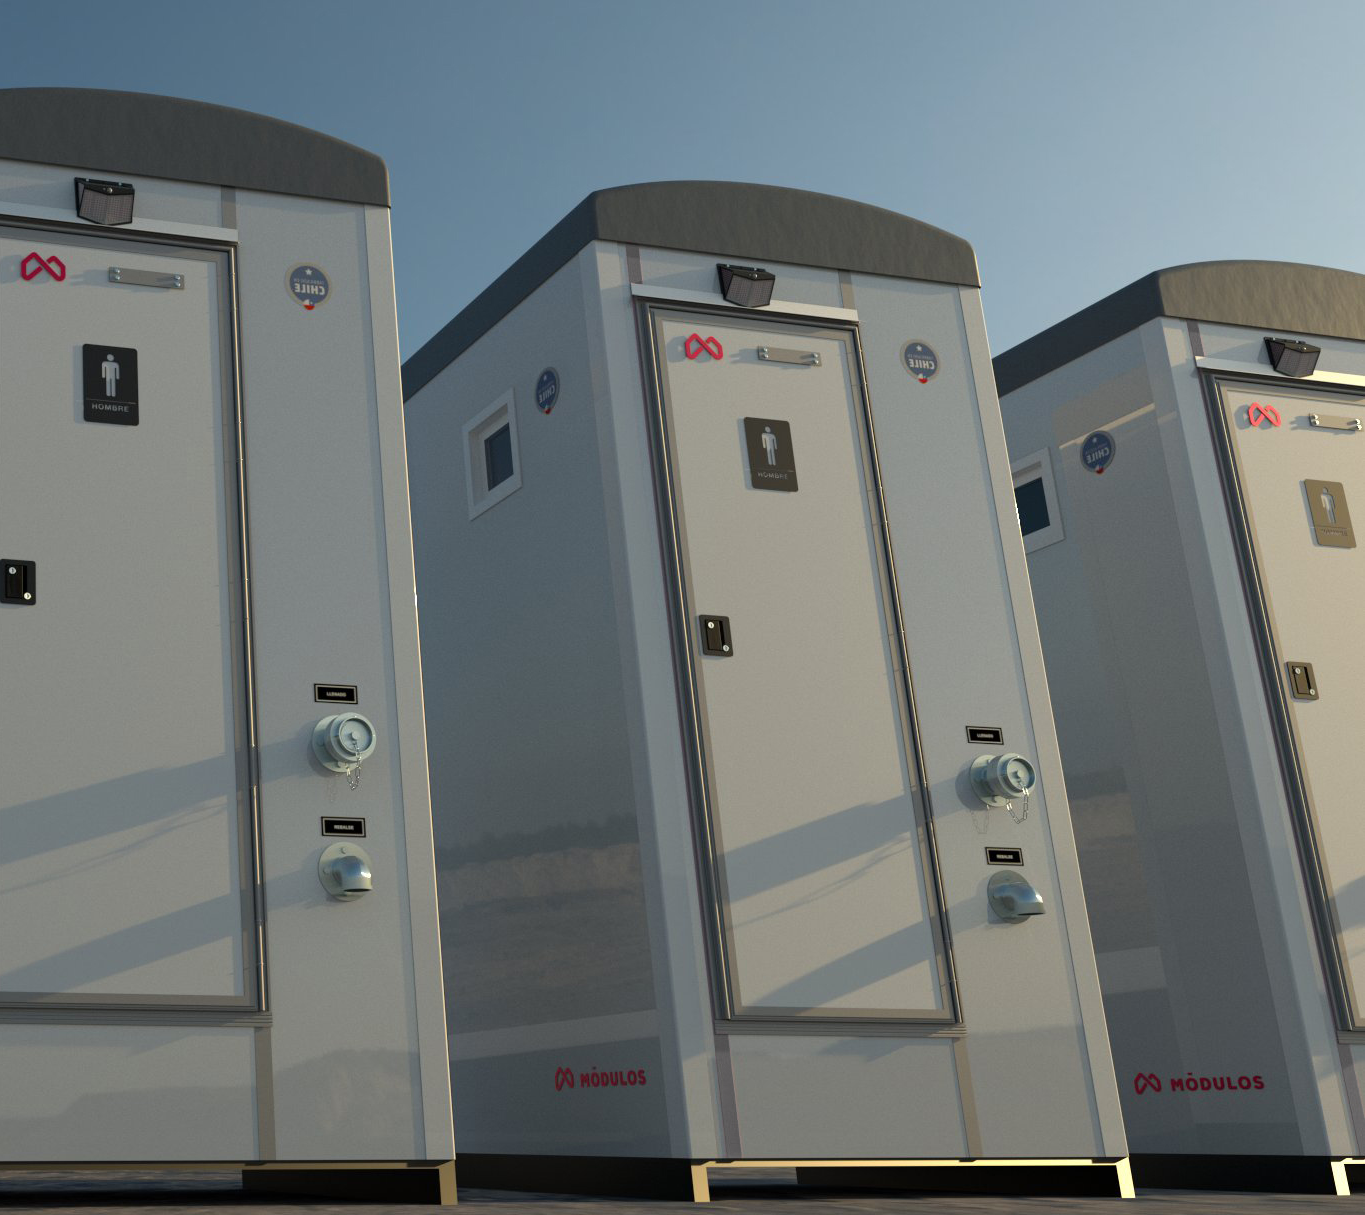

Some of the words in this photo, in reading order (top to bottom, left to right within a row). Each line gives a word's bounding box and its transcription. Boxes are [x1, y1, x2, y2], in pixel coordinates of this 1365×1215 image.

[91, 402, 130, 413] HOMBRE
[580, 1066, 647, 1089] MÓDULOS
[1170, 1072, 1265, 1092] MÓDULOS
